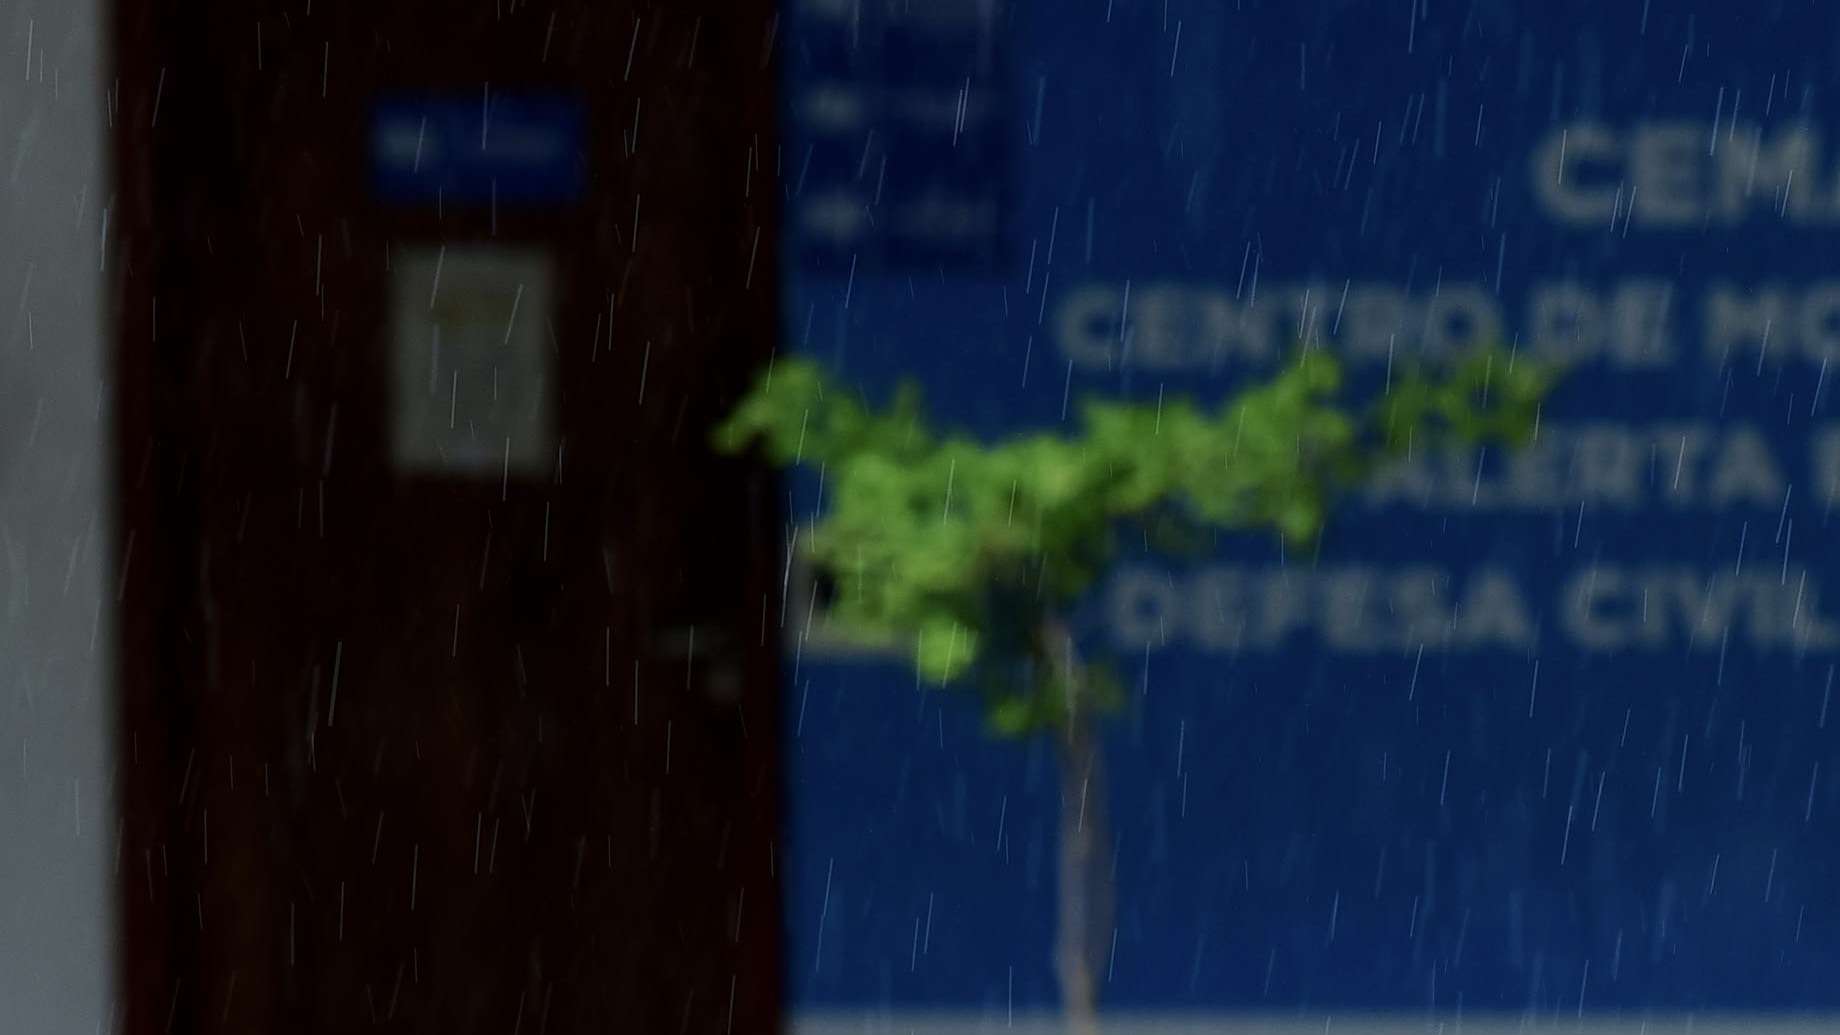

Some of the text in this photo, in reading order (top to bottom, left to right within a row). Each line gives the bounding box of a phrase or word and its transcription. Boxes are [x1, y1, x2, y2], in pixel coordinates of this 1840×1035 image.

[1057, 283, 1503, 365] CENTRO
[1529, 283, 1675, 365] DE
[1106, 567, 1537, 648] DEFESA
